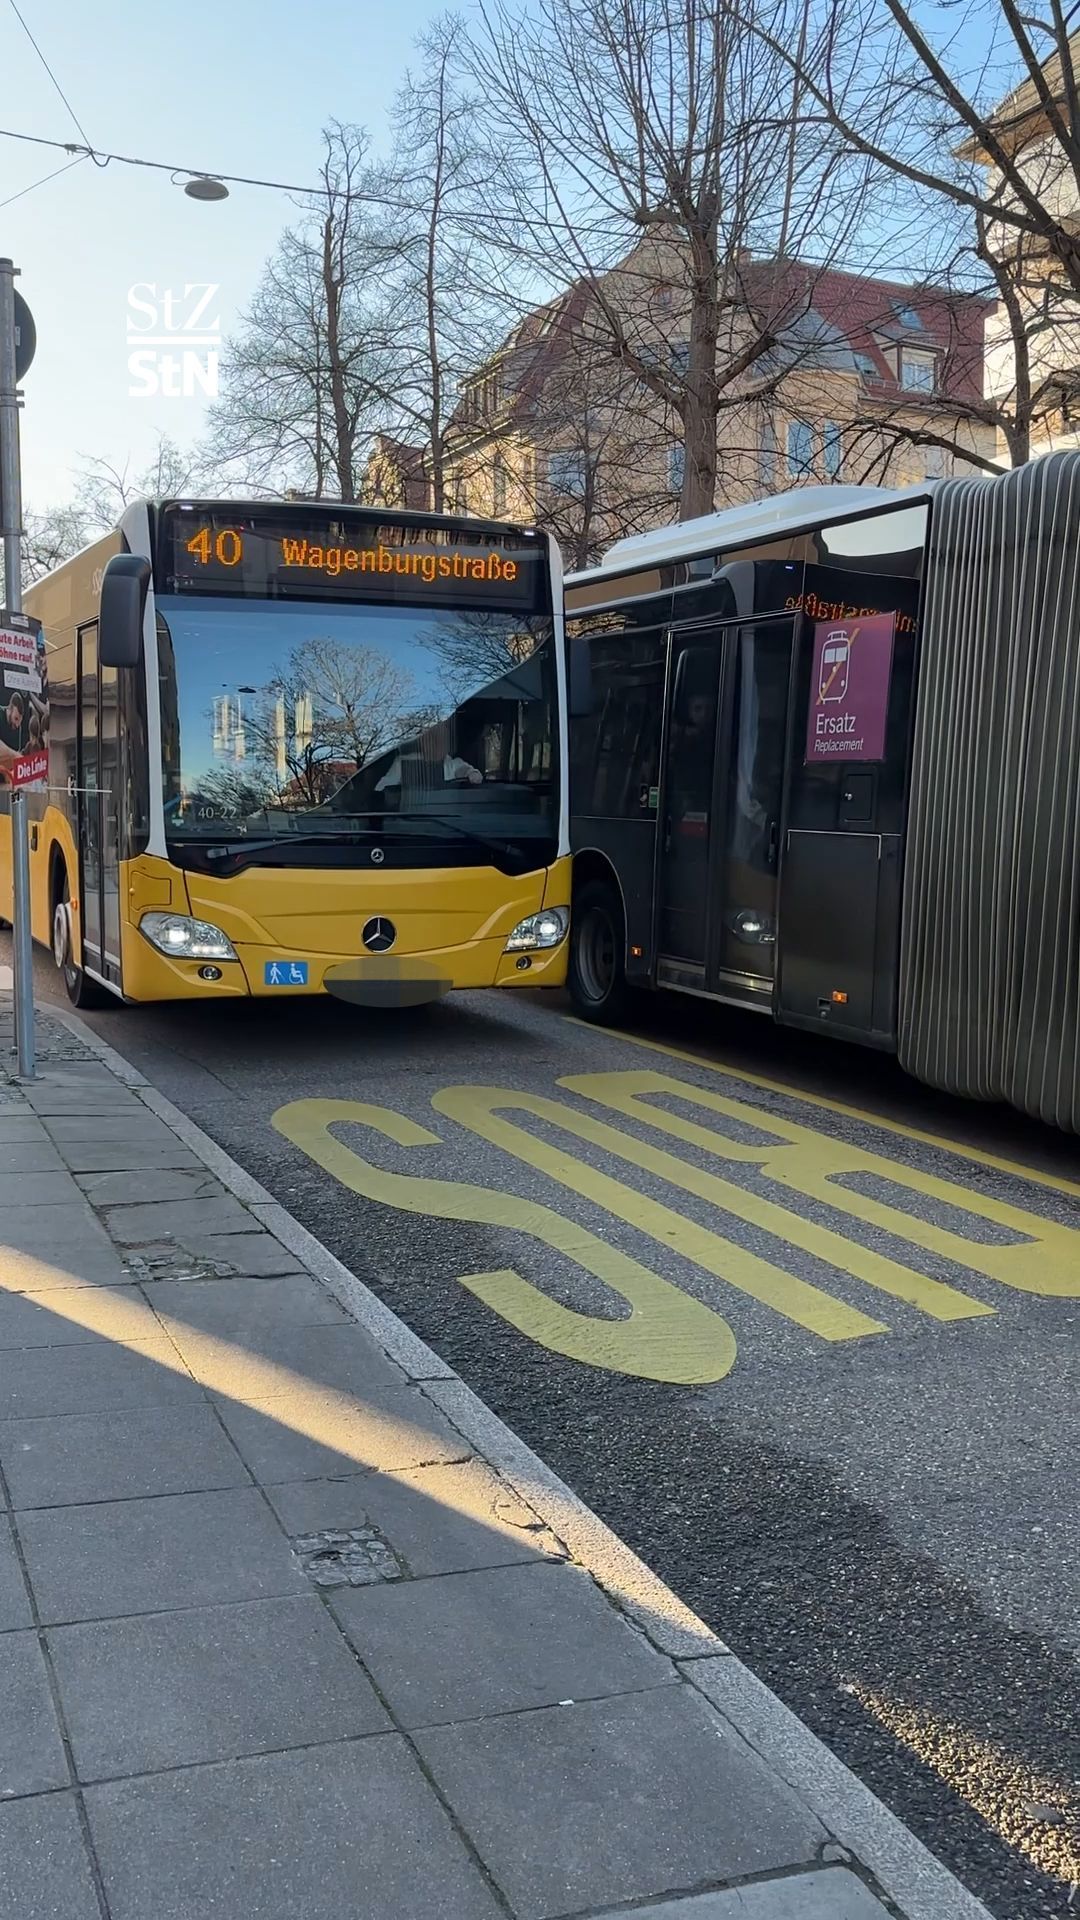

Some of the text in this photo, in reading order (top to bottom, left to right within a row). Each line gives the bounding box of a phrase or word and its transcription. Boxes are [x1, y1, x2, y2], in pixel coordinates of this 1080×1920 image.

[187, 528, 518, 582] 40 Wagenburgstraße
[0, 632, 14, 645] ute
[0, 646, 18, 661] öhne
[816, 712, 856, 735] Ersatz
[814, 738, 864, 754] Replacement
[17, 762, 31, 779] Die
[198, 806, 238, 819] 40-22
[270, 1070, 1080, 1385] BUS
